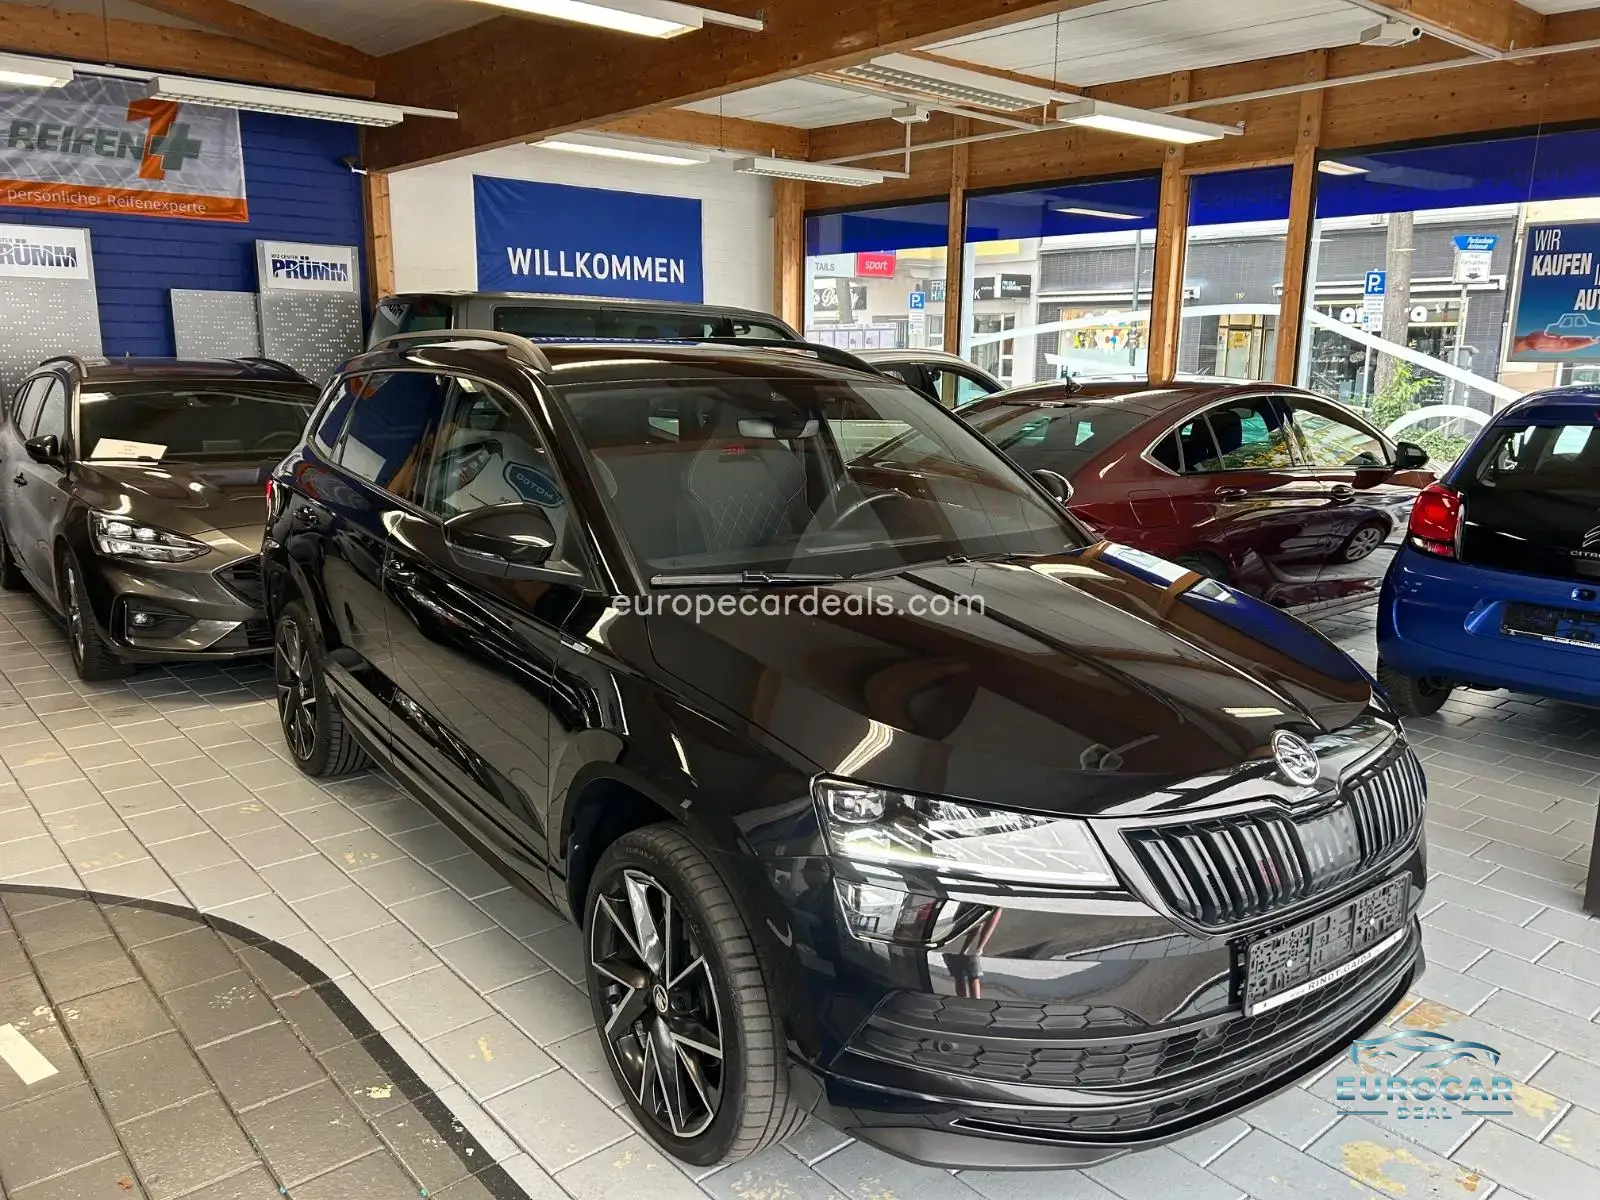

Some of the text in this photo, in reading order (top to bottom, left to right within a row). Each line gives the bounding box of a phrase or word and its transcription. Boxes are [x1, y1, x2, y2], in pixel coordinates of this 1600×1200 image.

[108, 194, 207, 214] Reifenexperte
[1535, 229, 1561, 251] WIR
[0, 239, 78, 268] RÜMM
[272, 255, 349, 282] PRÜMM
[507, 247, 685, 284] WILLKOMMEN
[815, 262, 835, 271] TAILS
[864, 261, 888, 272] sport
[1531, 253, 1592, 276] KAUFEN
[1368, 274, 1381, 293] P
[911, 294, 921, 308] P
